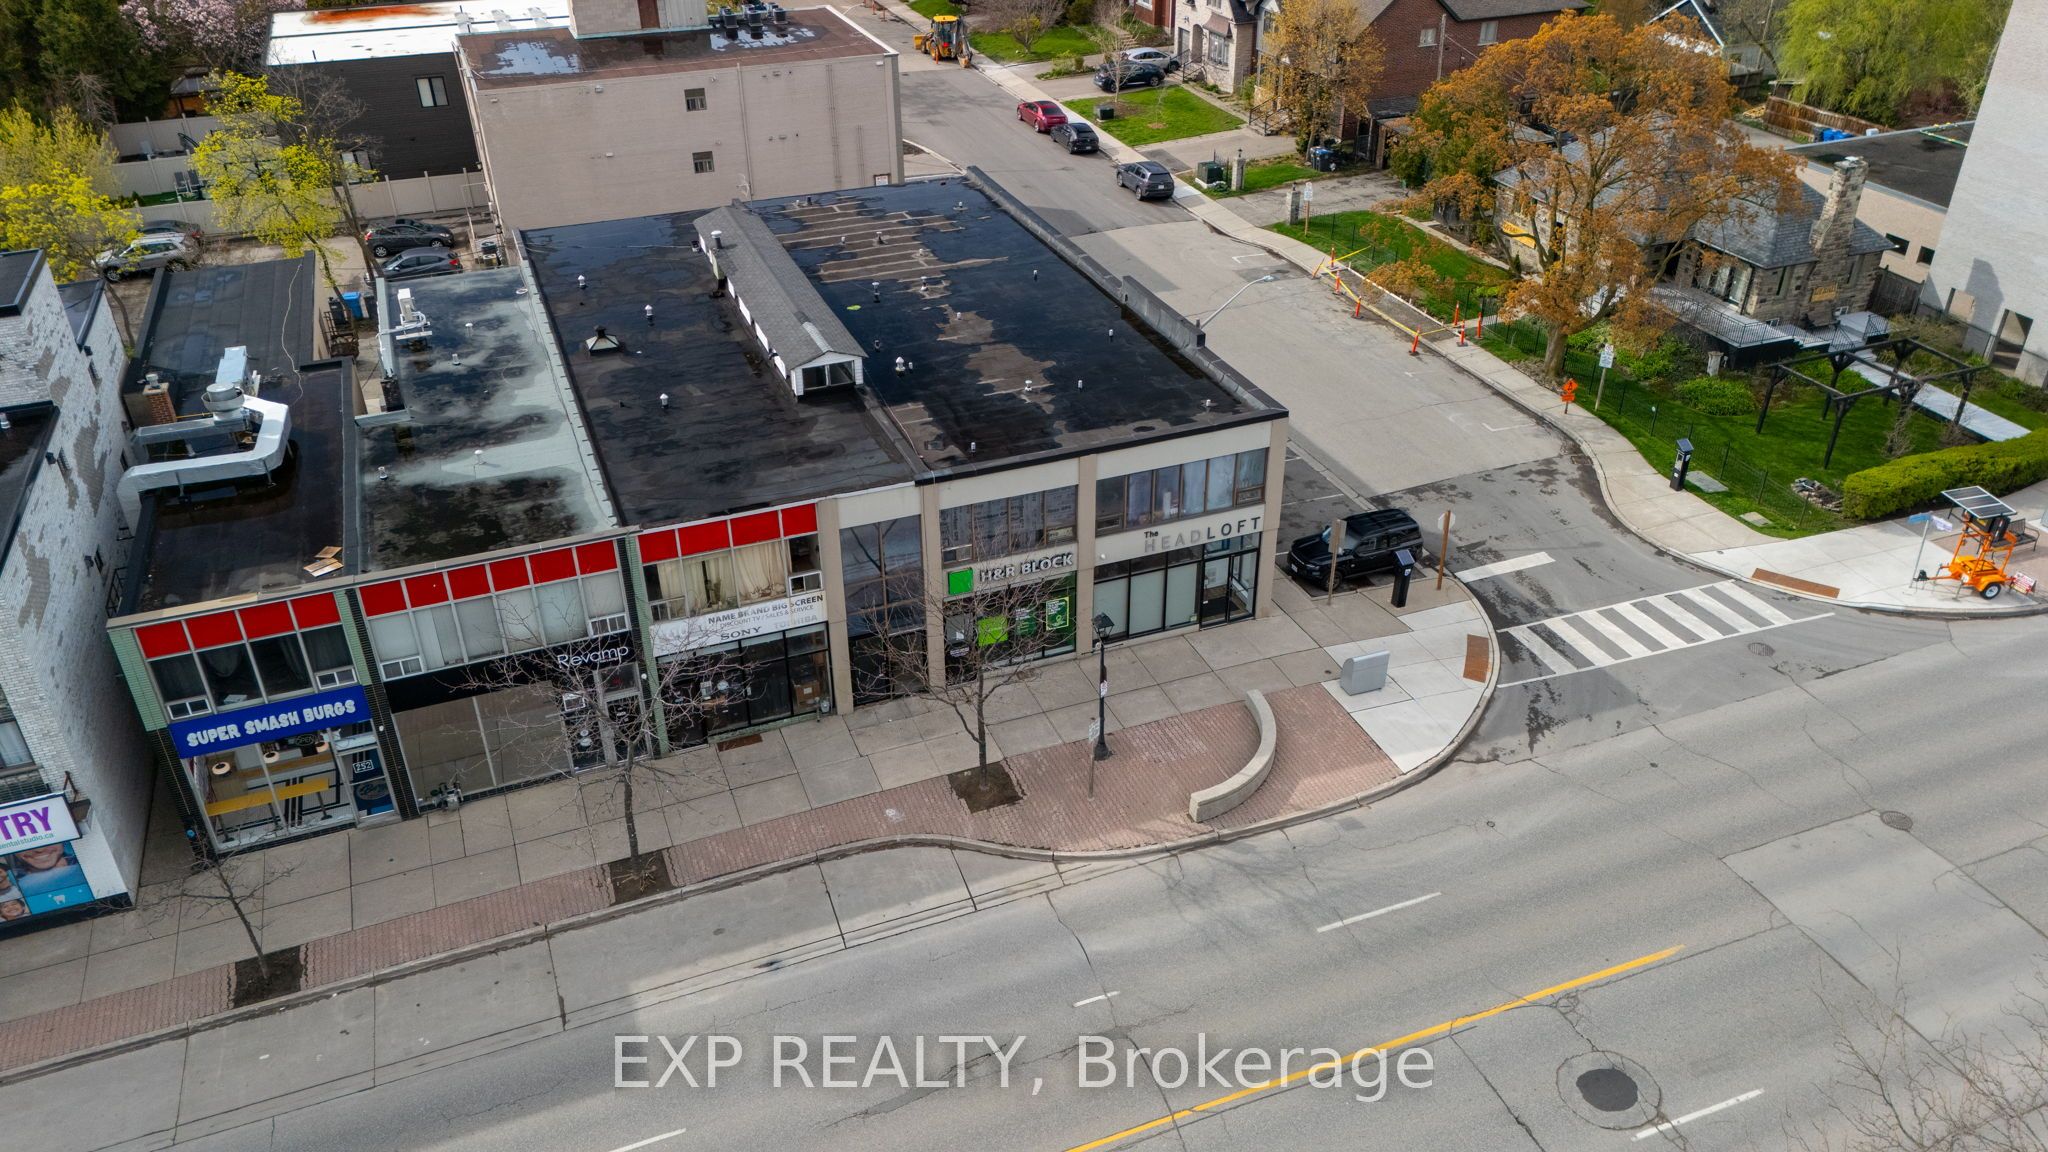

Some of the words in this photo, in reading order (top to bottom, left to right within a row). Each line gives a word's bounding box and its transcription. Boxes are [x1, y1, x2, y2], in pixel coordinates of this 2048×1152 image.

[1144, 530, 1159, 539] The
[1144, 529, 1202, 553] HEAD
[1206, 516, 1262, 540] LOFT
[979, 564, 1016, 582] H&R
[1020, 552, 1074, 575] BLOCK
[708, 613, 736, 624] NAME
[738, 607, 770, 619] BRAND
[772, 601, 788, 612] BIG
[720, 626, 761, 641] SONY
[557, 646, 629, 669] Revamp
[186, 723, 242, 748] SUPER
[244, 711, 301, 735] SMASH
[302, 699, 356, 723] BURGS
[355, 762, 372, 771] 252
